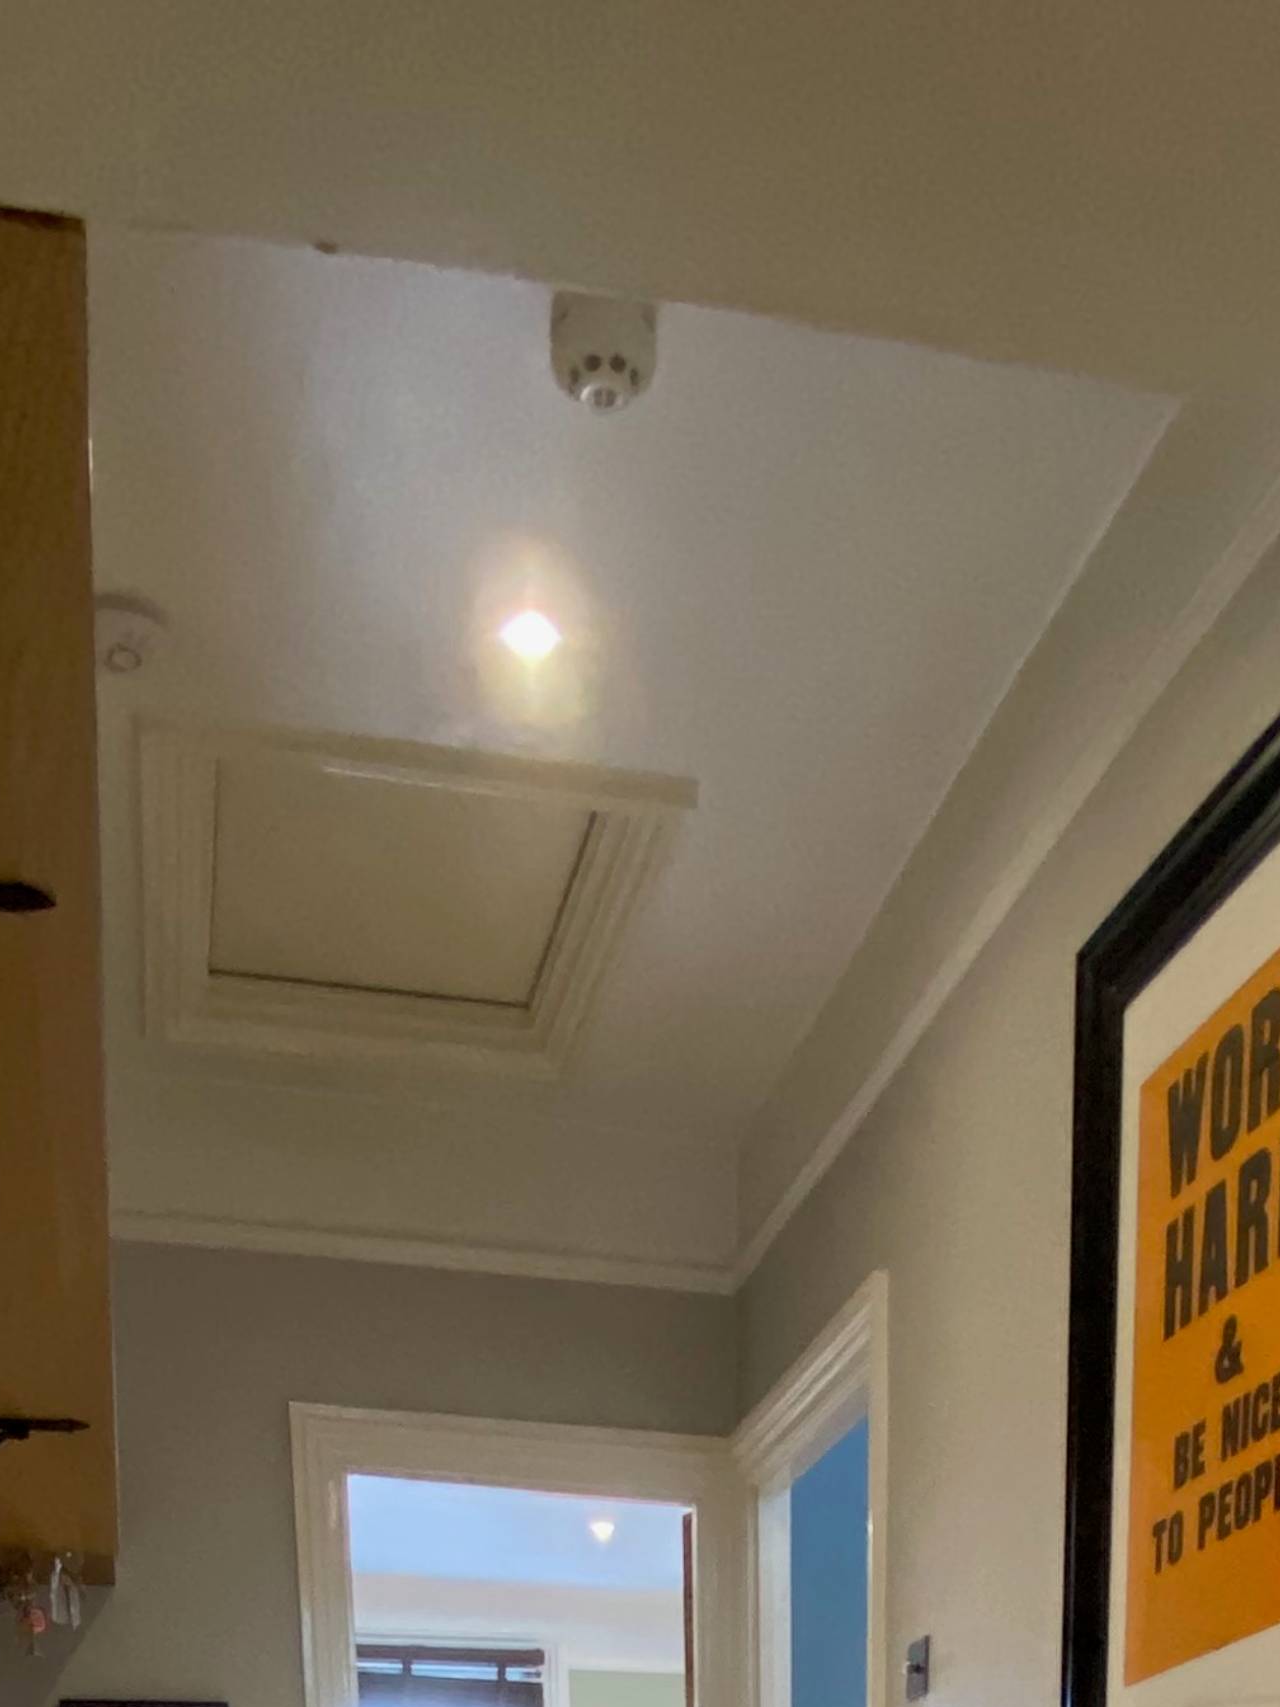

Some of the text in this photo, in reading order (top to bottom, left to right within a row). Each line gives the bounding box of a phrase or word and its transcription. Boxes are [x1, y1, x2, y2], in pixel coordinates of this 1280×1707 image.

[1215, 1314, 1244, 1384] &
[1173, 1418, 1206, 1491] BE
[1153, 1510, 1184, 1575] TO
